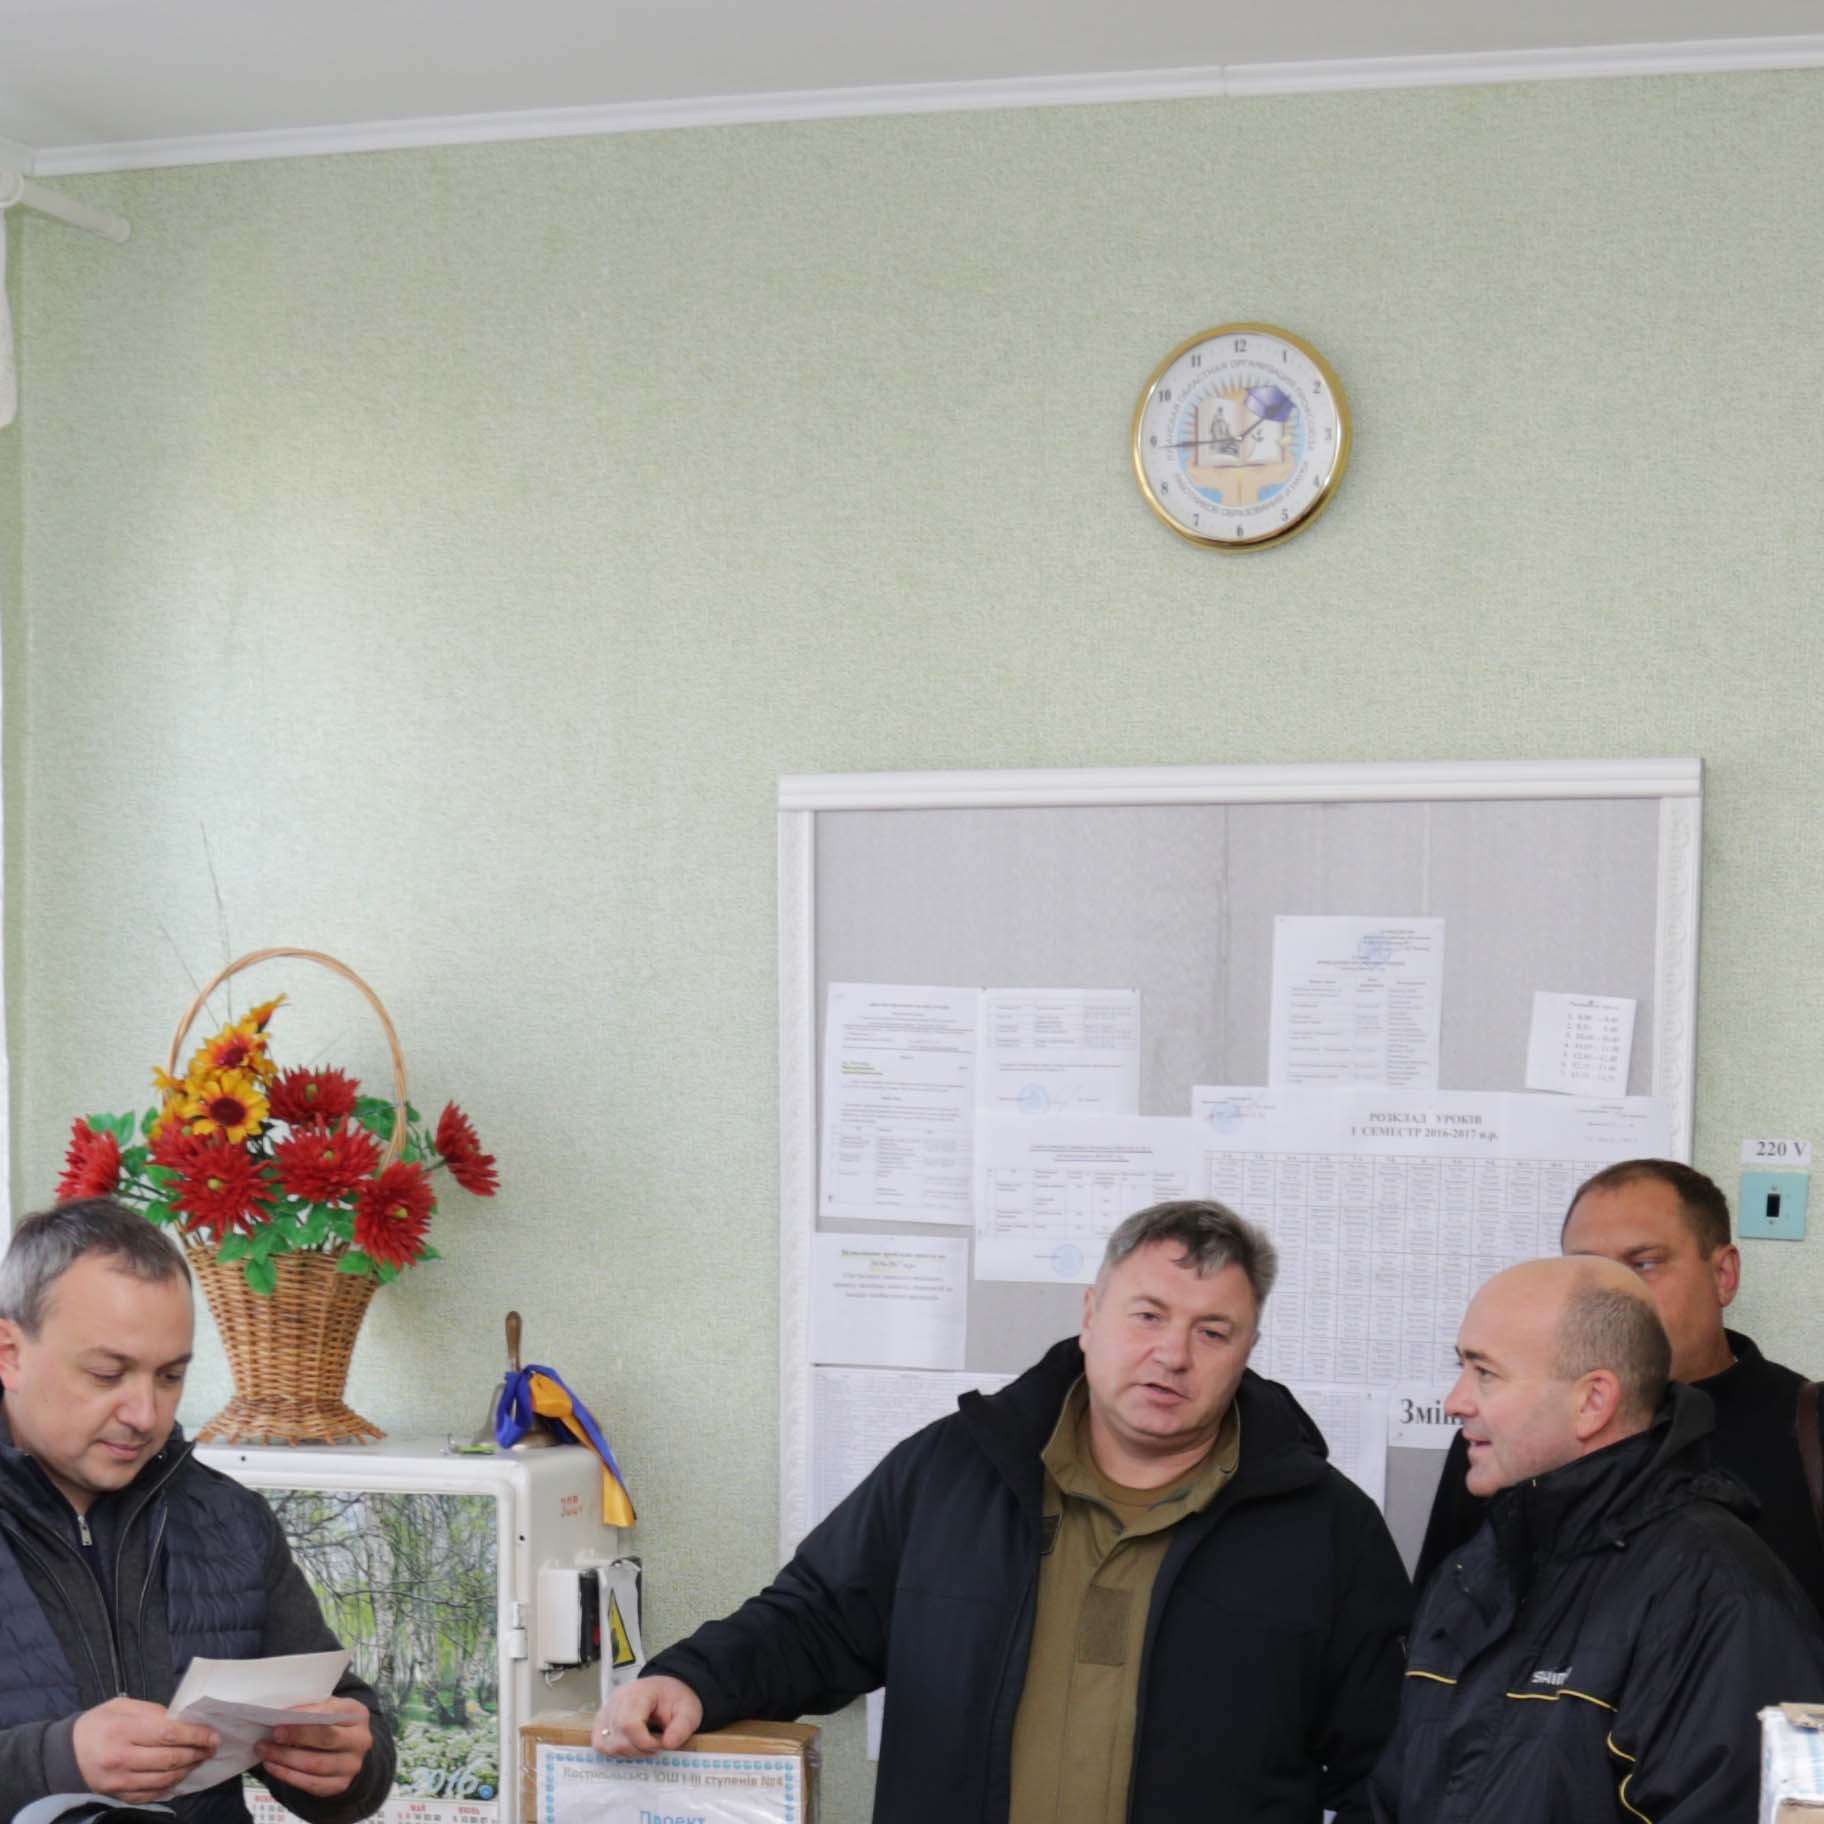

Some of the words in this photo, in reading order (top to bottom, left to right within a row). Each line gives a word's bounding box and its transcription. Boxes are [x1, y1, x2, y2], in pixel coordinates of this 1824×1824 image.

[1234, 339, 1247, 352] 12
[1191, 355, 1201, 367] 11
[1158, 389, 1171, 402] 10
[1369, 1112, 1426, 1124] РОЗКЛАД
[1436, 1114, 1482, 1125] УРОКІВ
[1362, 1126, 1421, 1138] СЕМЕСТР
[1425, 1127, 1476, 1139] 2016-2017
[1756, 1141, 1787, 1156] 220
[1793, 1142, 1807, 1156] V
[413, 1764, 480, 1795] 2016
